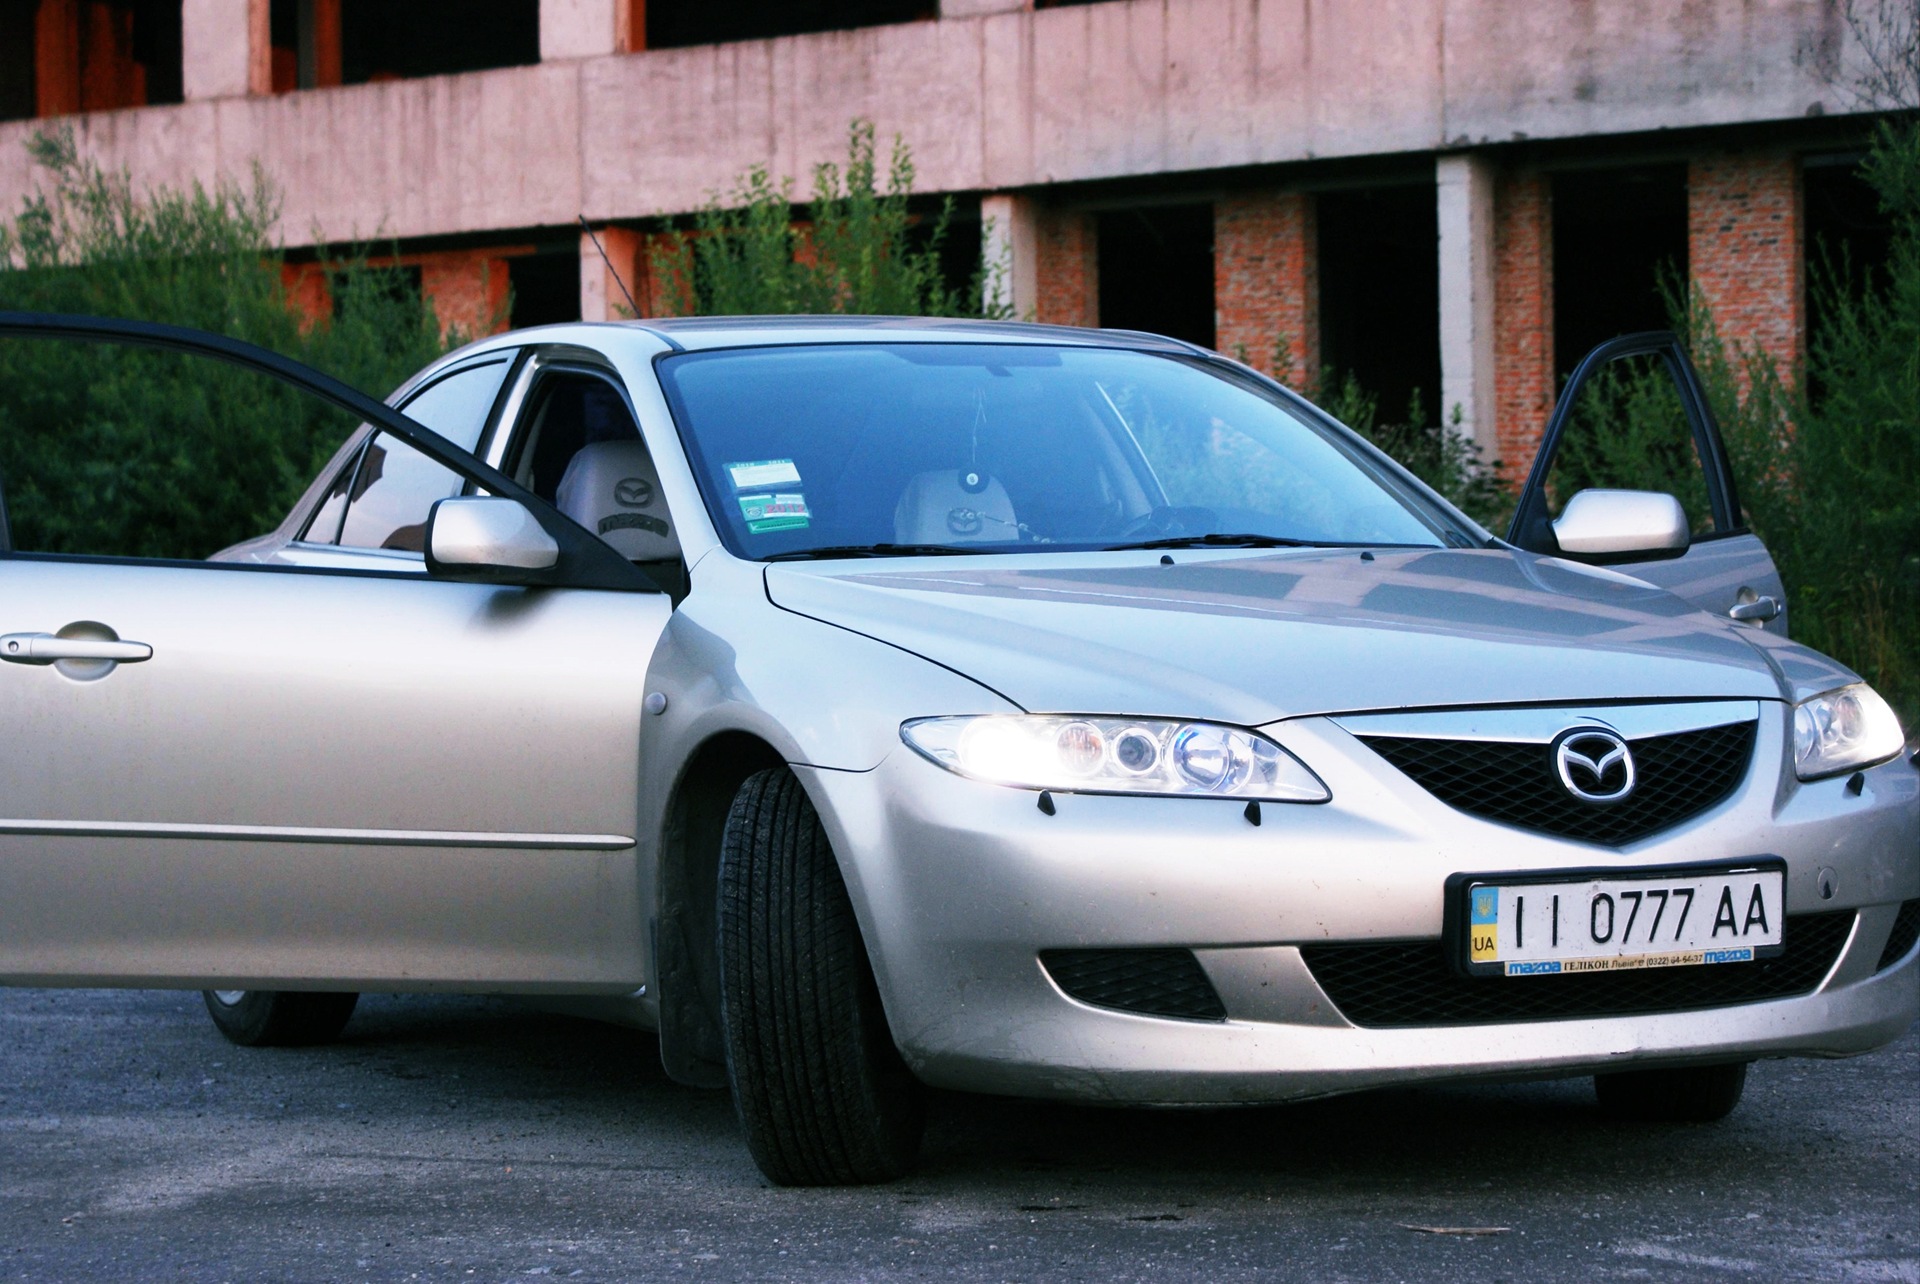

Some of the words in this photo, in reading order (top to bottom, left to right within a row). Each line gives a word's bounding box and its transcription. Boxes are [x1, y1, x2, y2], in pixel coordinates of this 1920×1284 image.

[765, 503, 806, 514] 2012
[1590, 887, 1695, 944] 0777
[1711, 883, 1769, 937] AA
[1474, 937, 1495, 952] UA
[1508, 960, 1562, 975] mazda
[1564, 960, 1609, 971] ГЕЛІКОН
[1646, 957, 1669, 967] (0322)
[1704, 948, 1752, 964] mazda
